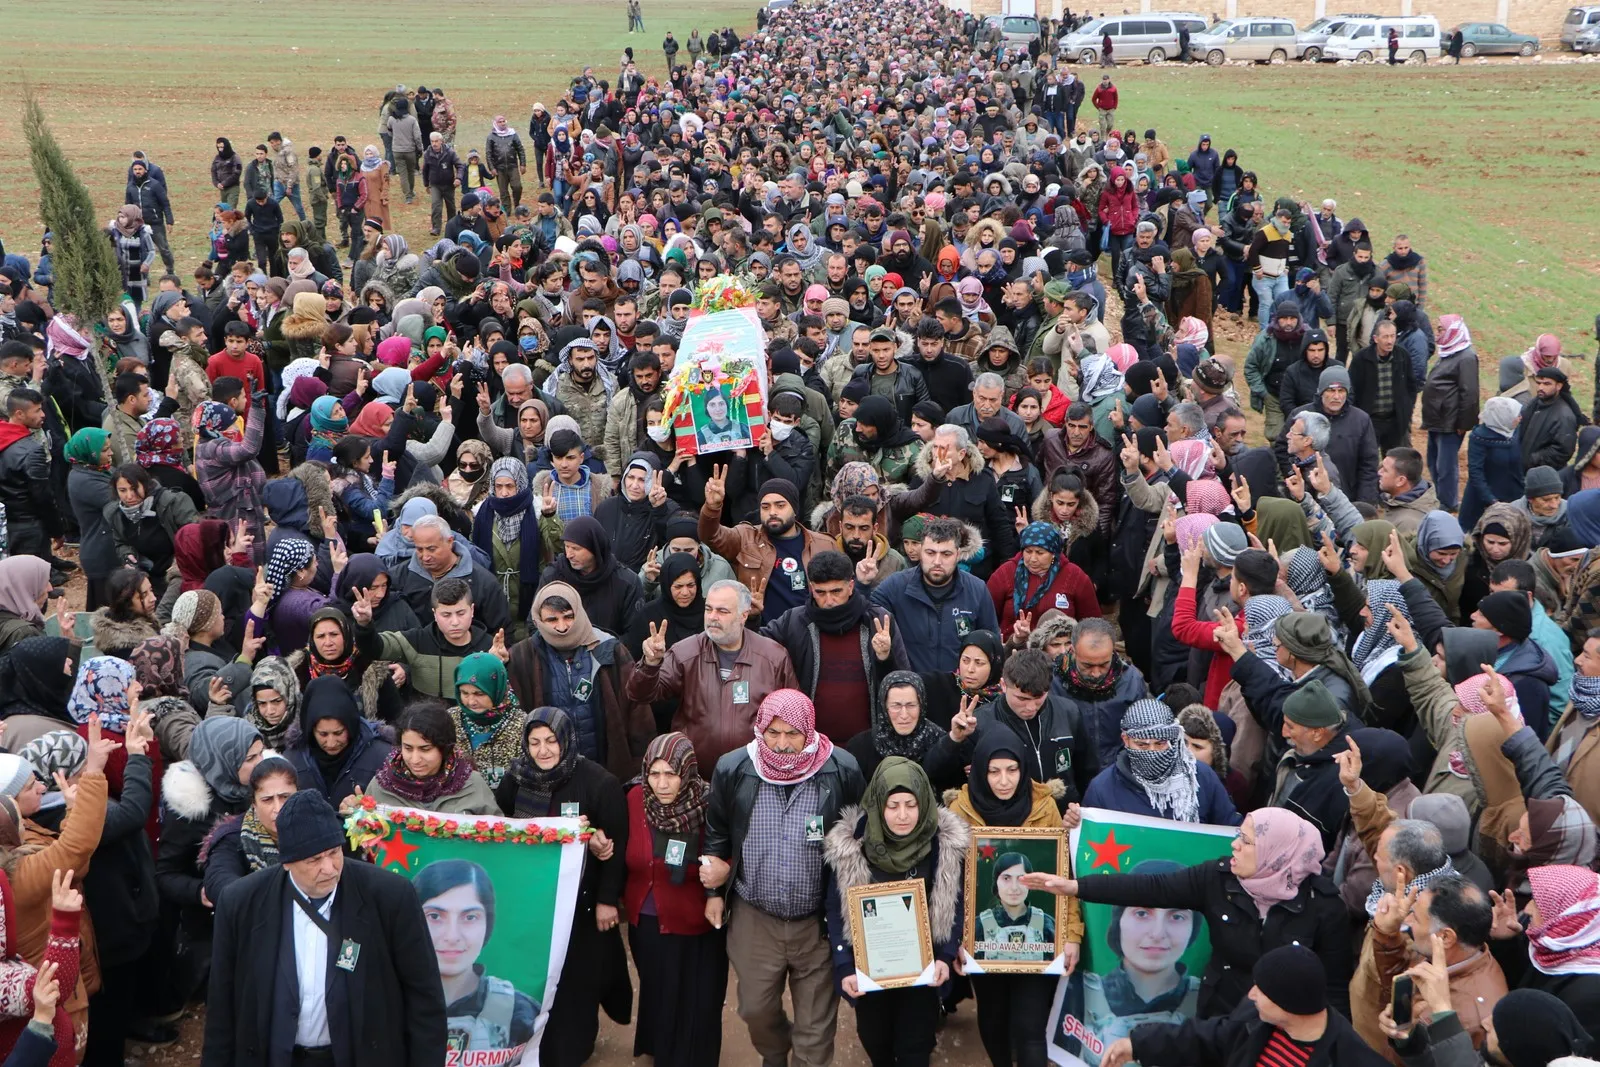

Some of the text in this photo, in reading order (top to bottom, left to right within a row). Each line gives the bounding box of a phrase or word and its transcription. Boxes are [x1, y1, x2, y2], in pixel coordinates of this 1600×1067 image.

[413, 857, 419, 866] J
[1084, 851, 1130, 865] Y J
[999, 942, 1021, 951] AWAZ
[1064, 1015, 1102, 1055] ŞEHİD
